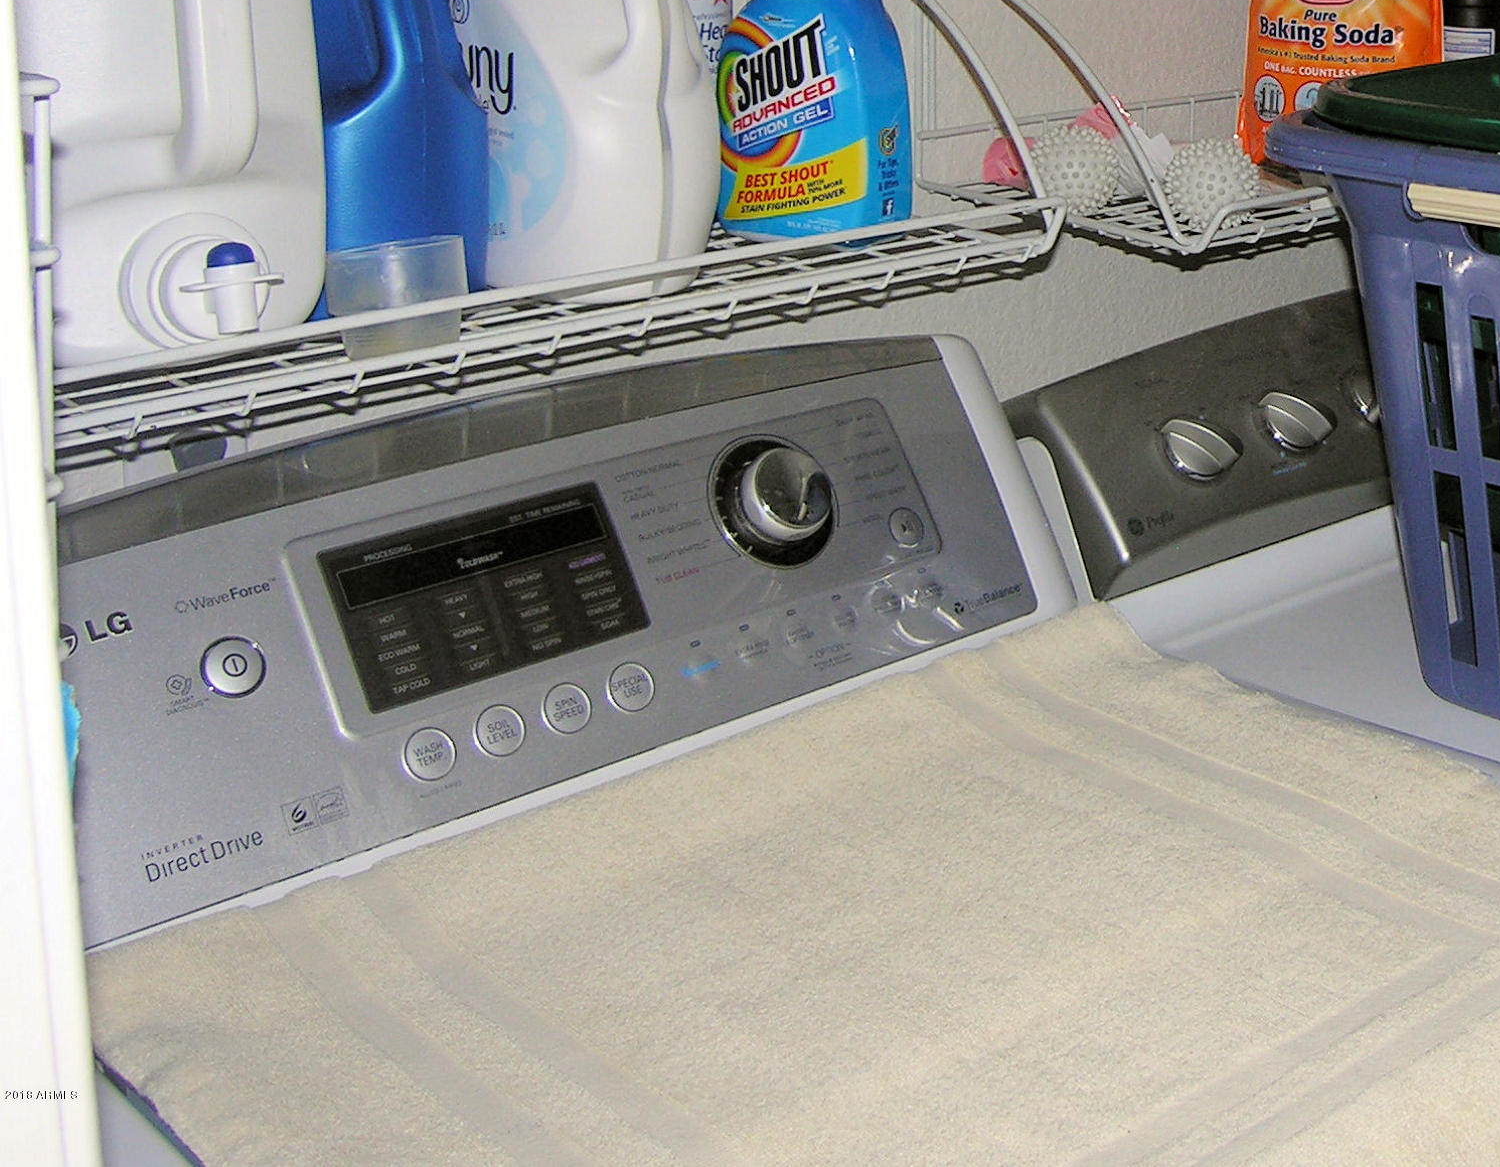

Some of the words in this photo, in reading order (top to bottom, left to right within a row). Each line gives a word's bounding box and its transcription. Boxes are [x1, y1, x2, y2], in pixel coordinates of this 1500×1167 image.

[1304, 9, 1337, 22] Pure
[1259, 16, 1327, 49] Baking
[1333, 23, 1395, 45] Soda
[735, 18, 823, 112] SHOUT
[1293, 50, 1320, 62] Trusted
[1321, 53, 1349, 65] Baking
[1350, 55, 1370, 64] Soda
[1371, 55, 1396, 64] Brand
[1264, 60, 1279, 73] ONE
[1298, 66, 1358, 78] COUNTLESS
[732, 76, 837, 134] ADVANCED
[741, 118, 788, 145] ACTION
[792, 104, 829, 125] GEL
[744, 171, 779, 189] BEST
[780, 160, 829, 185] SHOUT
[736, 183, 807, 204] FORMULA
[824, 178, 843, 192] MORE
[741, 202, 765, 214] STAIN
[766, 197, 811, 212] FIGHTING
[812, 188, 846, 205] POWER
[363, 543, 413, 562] PROCESSING
[444, 593, 469, 606] HEAVY
[84, 610, 134, 644] LG
[378, 613, 396, 625] HOT
[380, 628, 408, 643] WARM
[452, 624, 486, 640] NORMAL
[378, 649, 395, 662] ECO
[395, 643, 421, 657] WARM
[394, 662, 418, 676] COLD
[468, 658, 491, 671] LIGHT
[391, 682, 409, 695] TAP
[409, 677, 431, 690] COLD
[611, 672, 649, 693] SPECIAL
[623, 683, 644, 699] USE
[554, 696, 578, 711] SPIN
[552, 705, 585, 723] SPEED
[486, 718, 511, 734] SOIL
[486, 726, 518, 746] LEVEL
[413, 739, 445, 759] WASH
[415, 751, 448, 768] TEMP.
[140, 833, 205, 861] INVERTER
